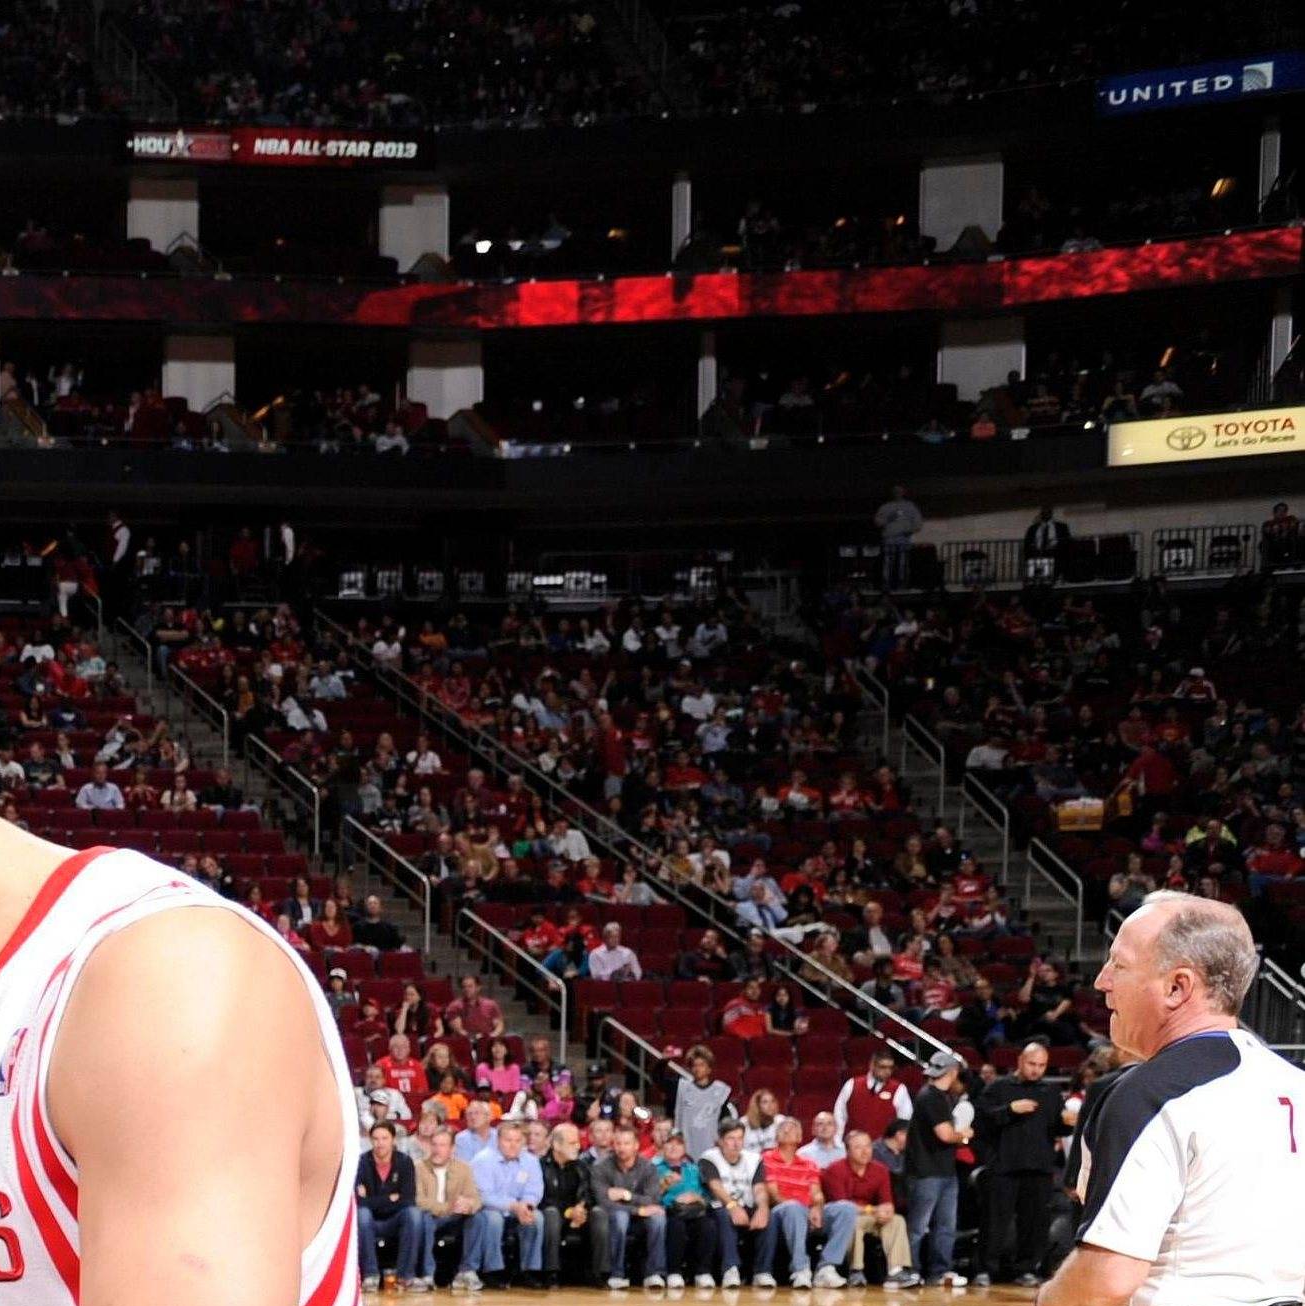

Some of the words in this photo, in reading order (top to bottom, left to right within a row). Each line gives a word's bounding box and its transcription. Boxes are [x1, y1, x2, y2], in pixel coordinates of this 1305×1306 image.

[1108, 74, 1233, 106] UNITED
[253, 138, 290, 155] NBA
[291, 139, 371, 157] ALL-STAR
[372, 141, 418, 158] 2013
[1213, 417, 1295, 437] TOYOTA
